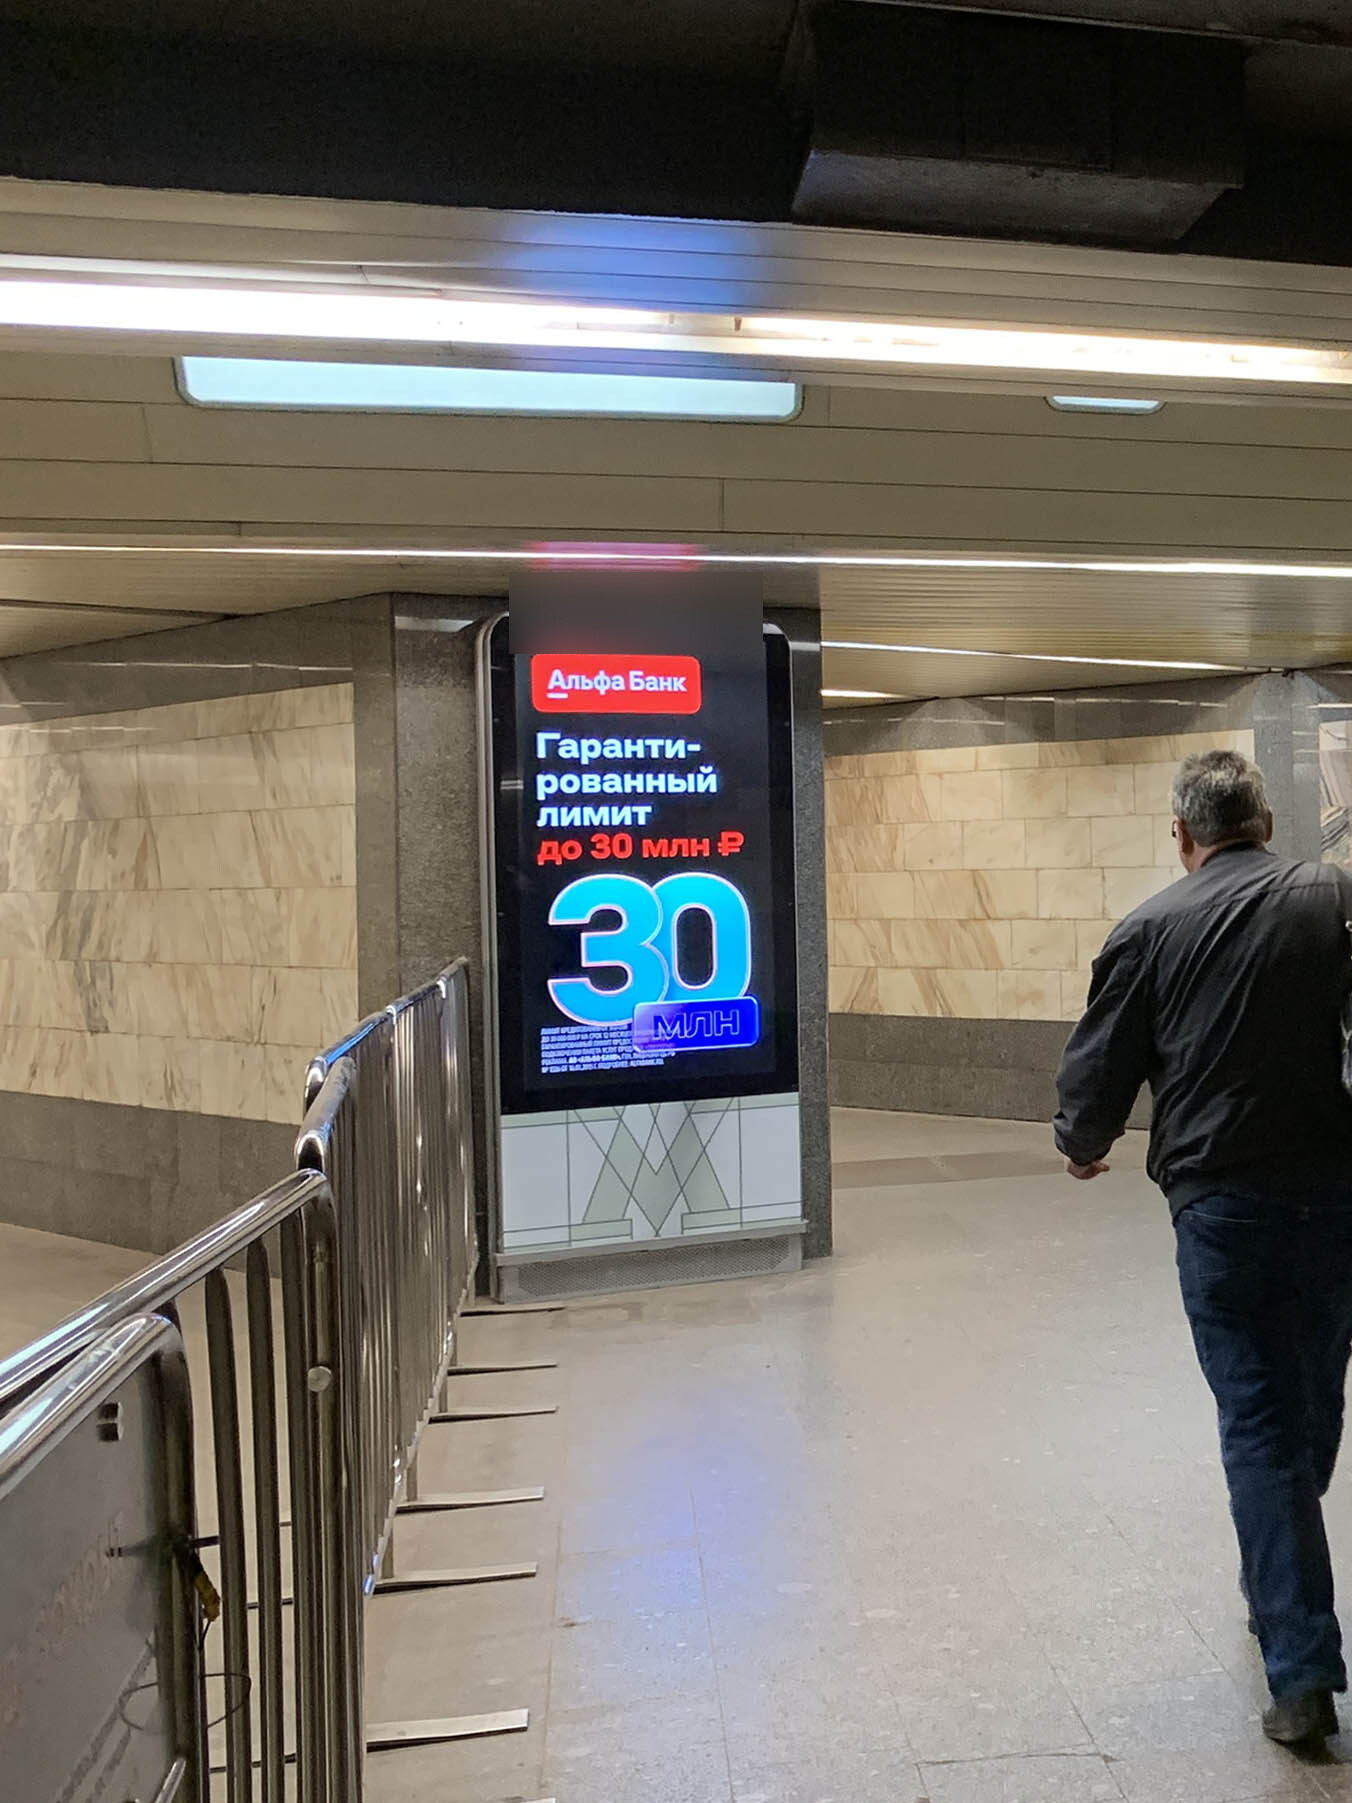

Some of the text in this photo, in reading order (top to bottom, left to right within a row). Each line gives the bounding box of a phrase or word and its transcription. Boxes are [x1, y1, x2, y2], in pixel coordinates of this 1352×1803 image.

[547, 669, 687, 698] Альфа Банк
[536, 732, 701, 765] Гаранти-
[536, 766, 718, 800] рованный
[536, 804, 652, 827] лимит
[537, 839, 582, 866] до
[590, 833, 633, 859] 30
[642, 838, 710, 858] млн
[547, 871, 751, 1026] 30
